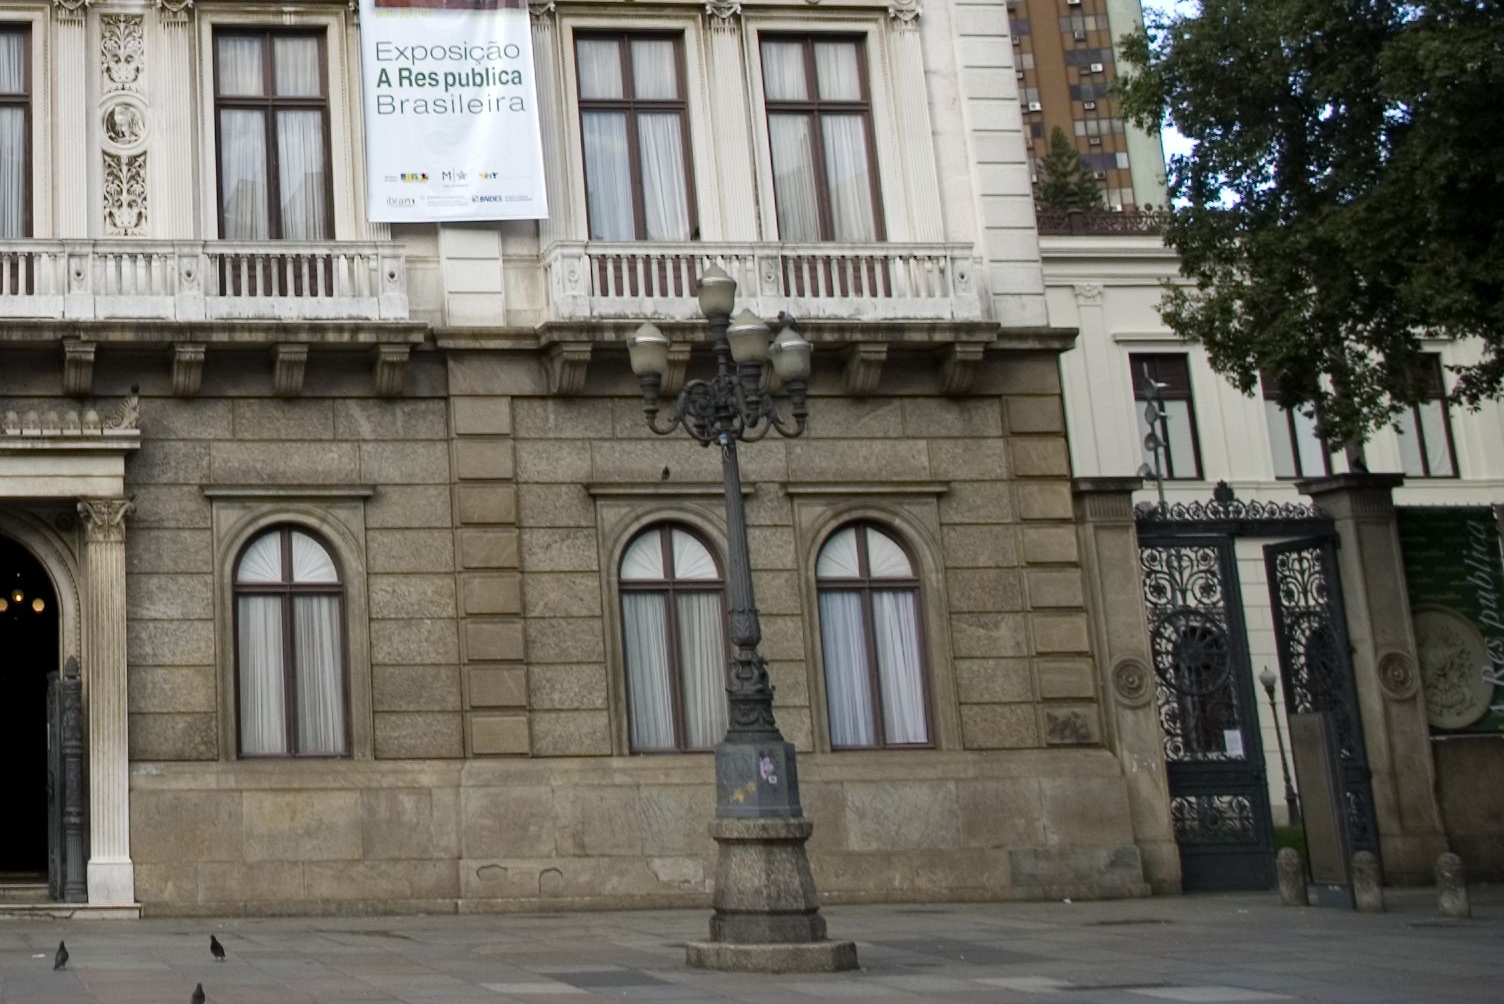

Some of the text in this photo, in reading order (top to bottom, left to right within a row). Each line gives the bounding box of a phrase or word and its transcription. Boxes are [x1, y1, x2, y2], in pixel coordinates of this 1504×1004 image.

[376, 41, 520, 66] Exposição
[376, 66, 522, 92] A Res publica
[377, 94, 526, 115] Brasileira
